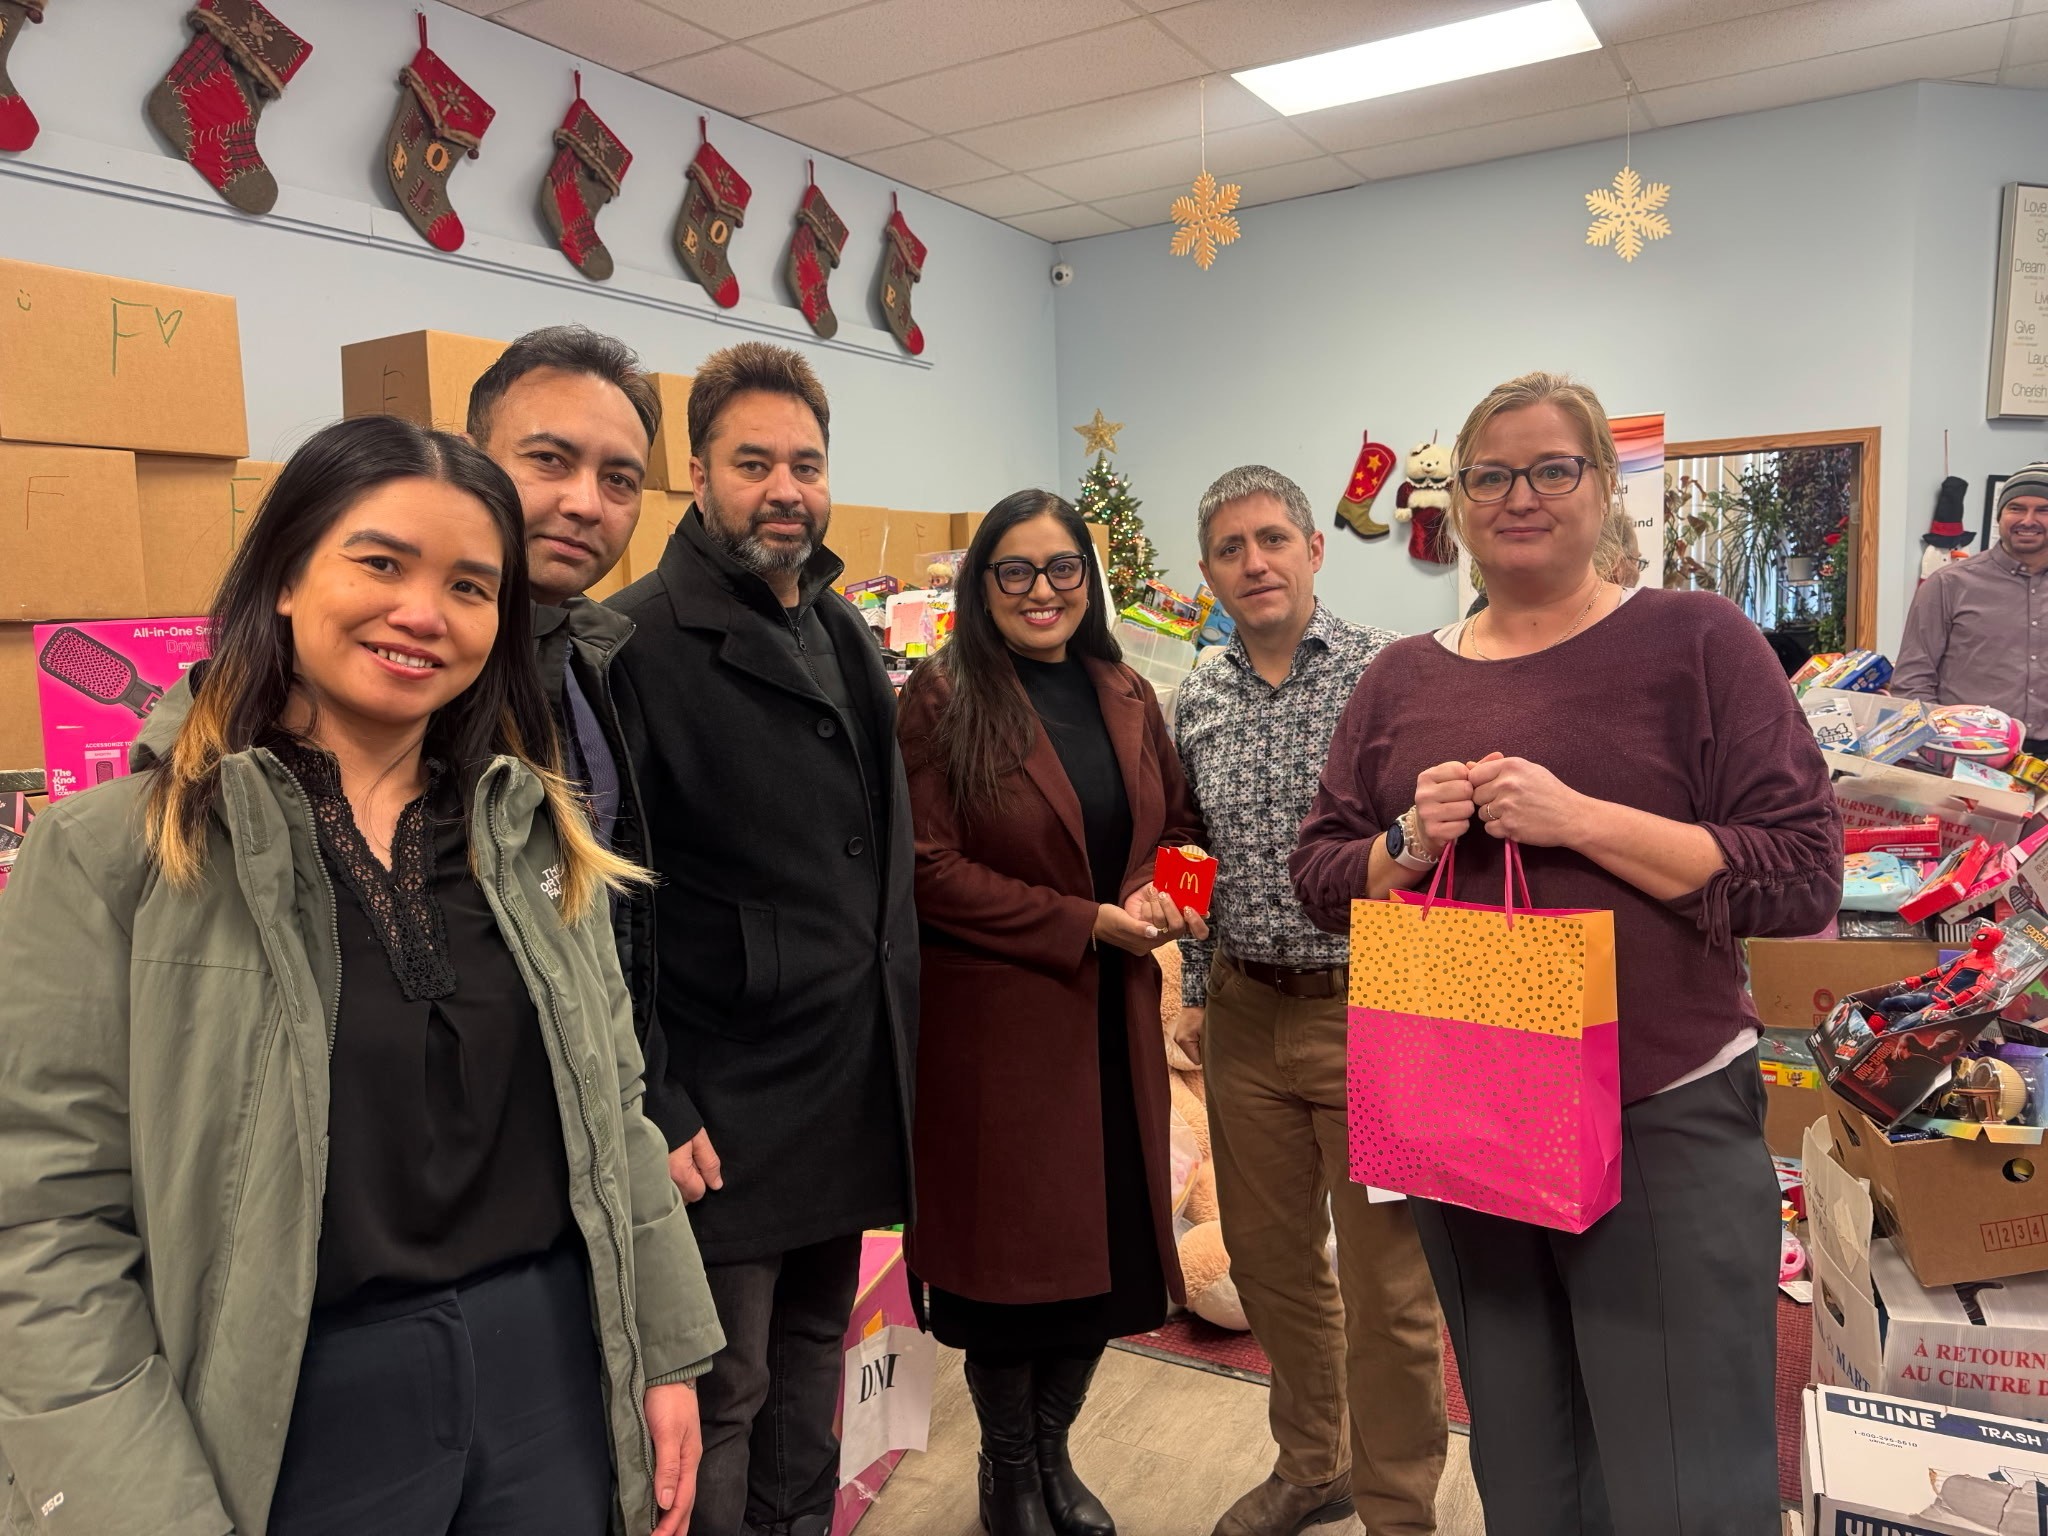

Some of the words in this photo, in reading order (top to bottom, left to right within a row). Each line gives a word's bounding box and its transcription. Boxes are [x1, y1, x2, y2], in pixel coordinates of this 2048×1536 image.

[426, 143, 449, 172] O
[2024, 198, 2047, 213] Love
[710, 220, 728, 245] O
[2014, 258, 2046, 273] Dream
[111, 297, 152, 377] F
[2014, 320, 2036, 335] Give
[2012, 383, 2048, 397] Cherish
[27, 475, 70, 530] F
[230, 477, 261, 550] F
[133, 626, 193, 638] All-in-One
[52, 769, 72, 777] The
[53, 776, 76, 785] Knot
[54, 784, 67, 792] Dr.
[1987, 1231, 1995, 1245] 1
[2002, 1228, 2010, 1243] 2
[2017, 1225, 2025, 1240] 3
[2033, 1222, 2040, 1238] 4
[1914, 1338, 1928, 1358] À
[1936, 1344, 2048, 1371] RETOURN
[1901, 1364, 1931, 1382] AU
[1939, 1370, 2031, 1395] CENTRE
[1848, 1400, 1936, 1429] ULINE
[1979, 1425, 2042, 1447] TRASH
